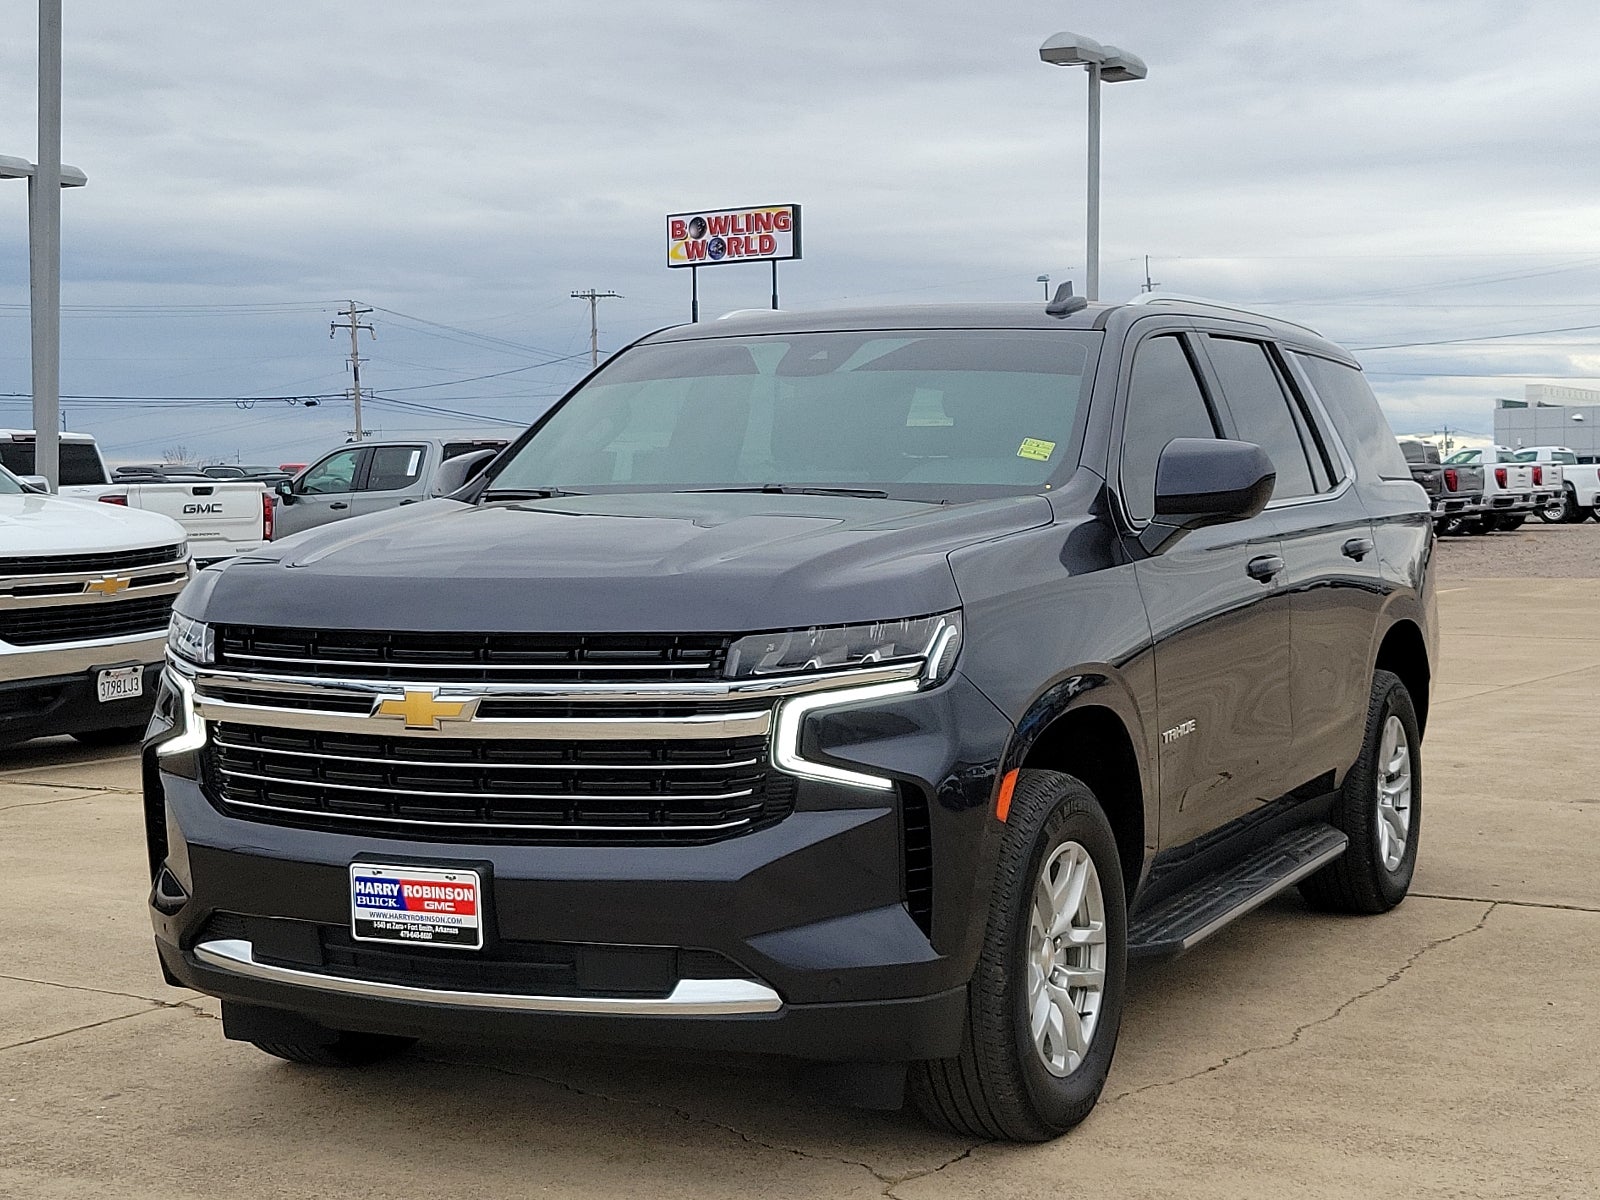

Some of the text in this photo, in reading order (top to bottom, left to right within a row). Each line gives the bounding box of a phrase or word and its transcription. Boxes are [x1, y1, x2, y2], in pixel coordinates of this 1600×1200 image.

[671, 211, 791, 241] BOWLING
[684, 235, 777, 260] WORLD
[183, 503, 223, 514] GMC
[100, 677, 139, 697] 37981J3
[1162, 719, 1196, 744] TAHOE
[355, 881, 474, 902] HARRY ROBINSON
[356, 895, 456, 911] BUICK GMC
[369, 911, 463, 925] WWW.HARRYROBINSON.COM
